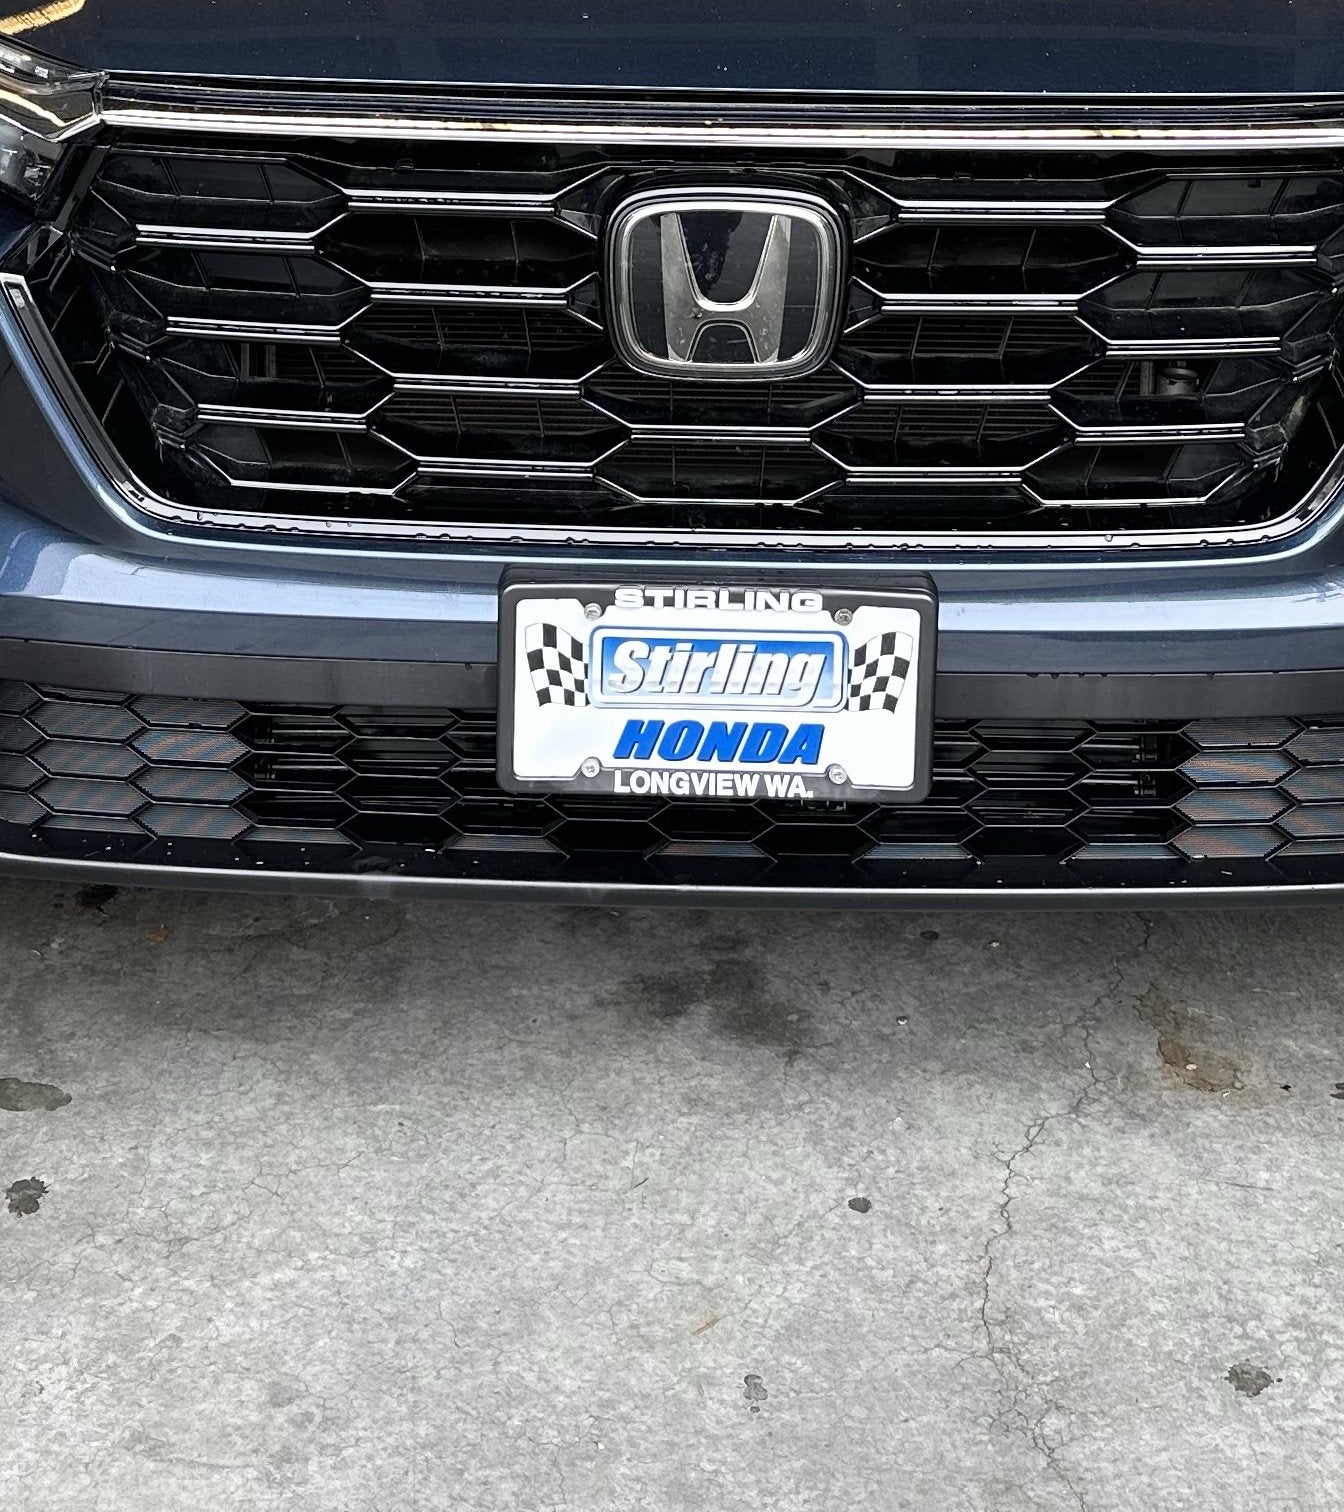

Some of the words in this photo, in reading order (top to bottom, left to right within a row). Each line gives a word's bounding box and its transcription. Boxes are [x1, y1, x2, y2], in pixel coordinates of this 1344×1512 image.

[614, 586, 823, 612] STIRLING
[609, 640, 826, 707] Stirling
[613, 719, 825, 765] HONDA
[613, 769, 761, 797] LONGVIEW
[763, 775, 814, 798] WA.
